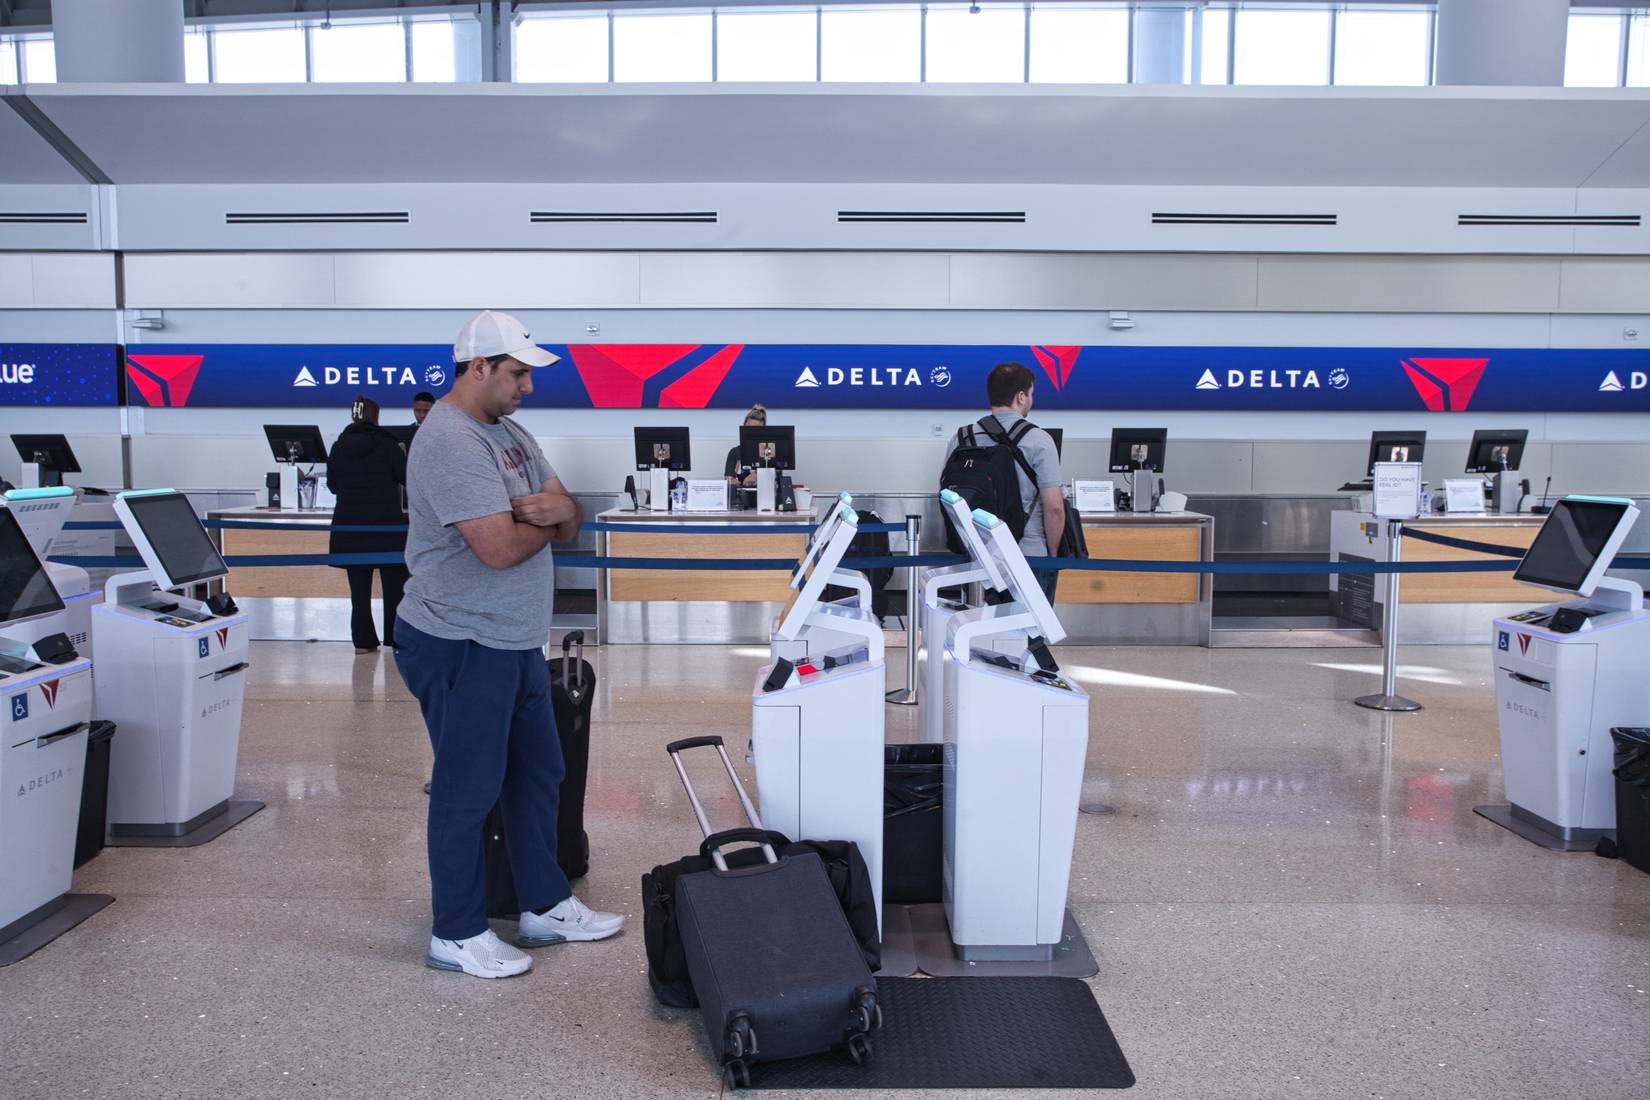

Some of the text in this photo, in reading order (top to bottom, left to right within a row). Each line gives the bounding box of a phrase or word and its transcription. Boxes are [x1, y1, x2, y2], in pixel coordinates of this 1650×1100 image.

[0, 363, 34, 384] ue
[324, 367, 417, 385] DELTA
[827, 367, 922, 386] DELTA
[1227, 369, 1321, 388] DELTA
[1631, 371, 1648, 390] D
[207, 699, 231, 714] DELTA
[1513, 702, 1540, 720] DELTA
[29, 769, 64, 791] DELTA
